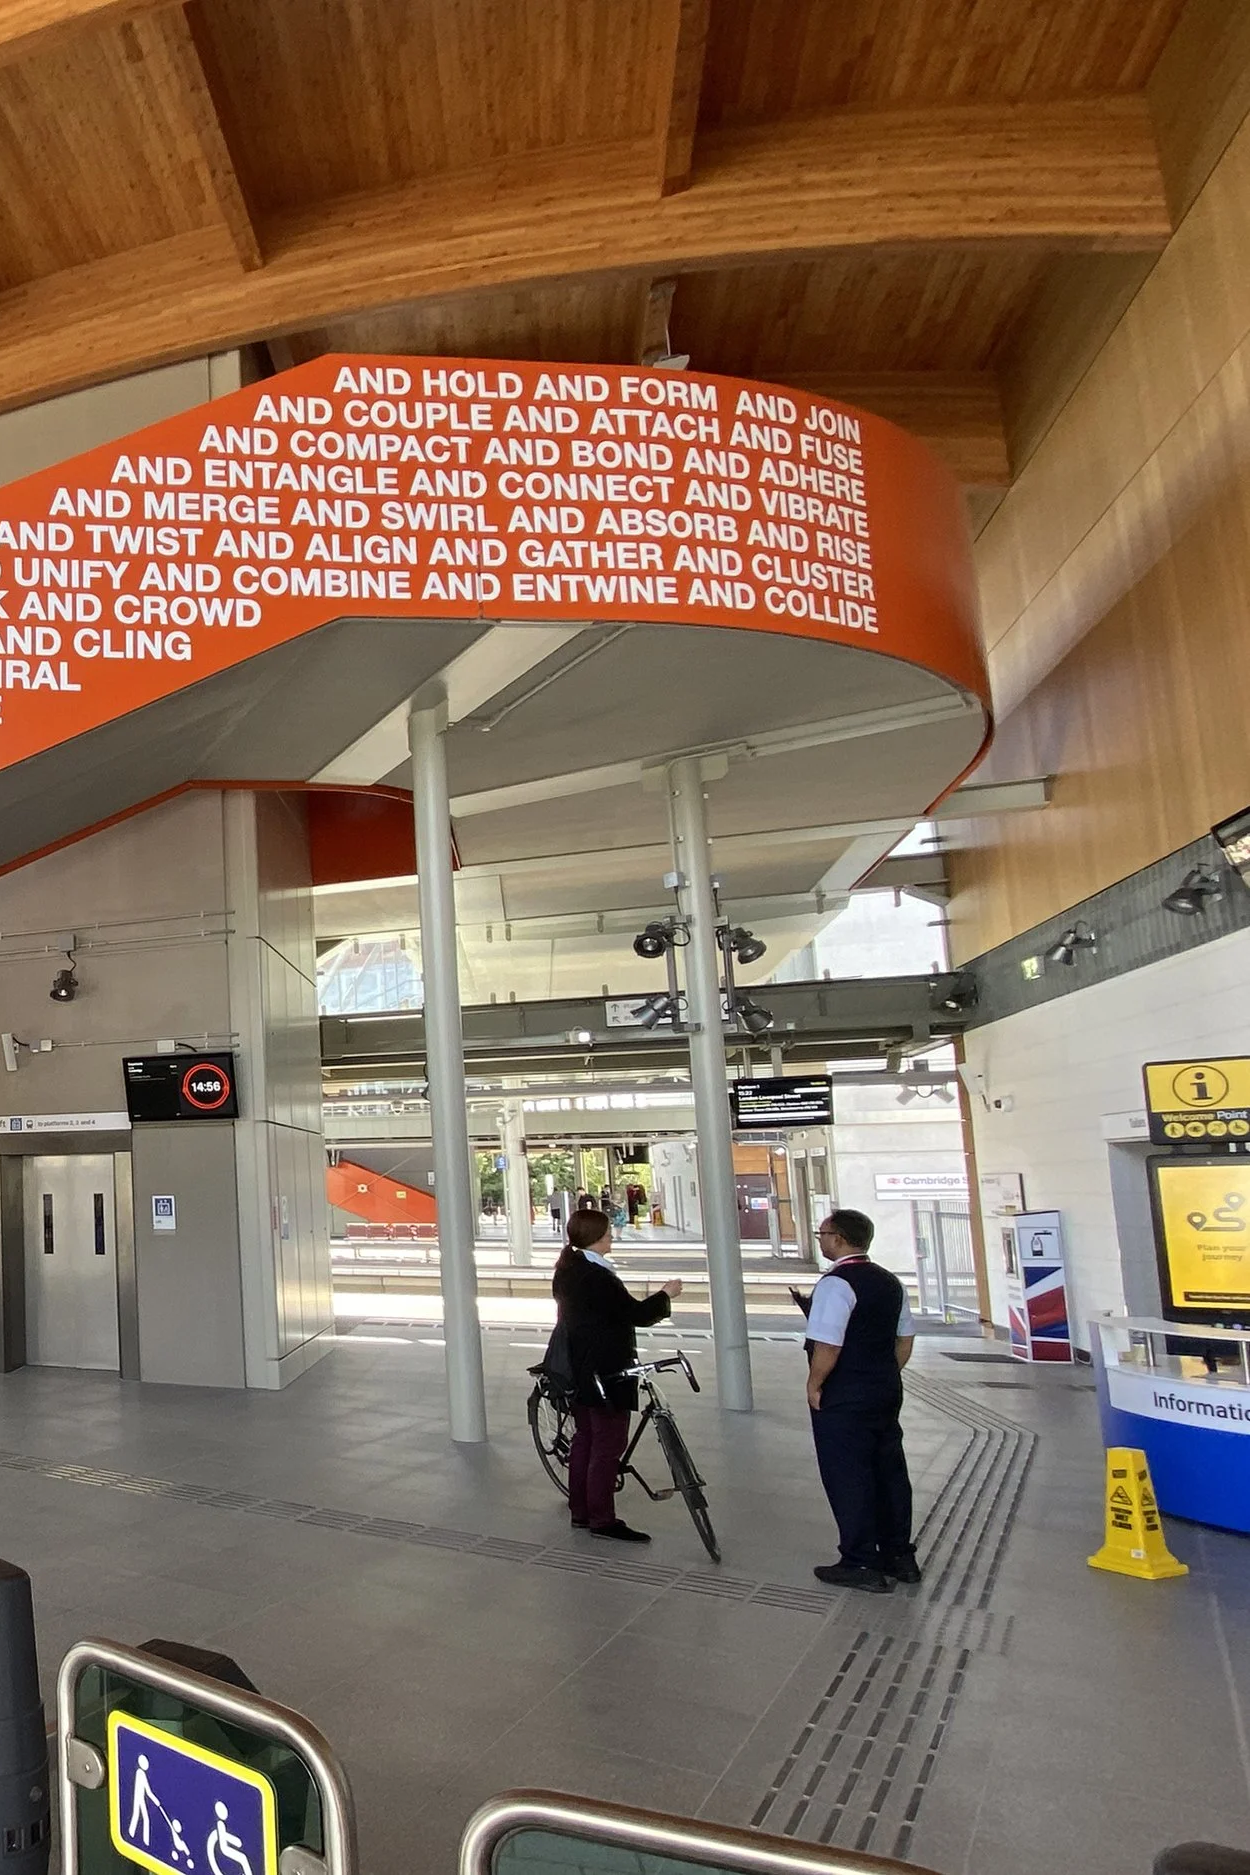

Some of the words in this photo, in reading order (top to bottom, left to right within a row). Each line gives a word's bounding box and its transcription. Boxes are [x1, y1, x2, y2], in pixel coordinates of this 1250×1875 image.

[253, 394, 333, 425] AND
[343, 399, 494, 431] COUPLE
[503, 405, 580, 434] AND
[589, 408, 721, 444] ATTACH
[729, 421, 792, 455] AND
[799, 433, 864, 476] FUSE
[333, 366, 412, 395] AND
[422, 369, 523, 399] HOLD
[533, 373, 610, 402] AND
[620, 376, 718, 412] FORM
[735, 390, 797, 424] AND
[805, 405, 860, 444] JOIN
[110, 455, 192, 486] AND
[204, 458, 400, 495] ENTANGLE
[409, 468, 488, 499] AND
[498, 471, 675, 503] CONNECT
[684, 479, 752, 511] AND
[758, 488, 869, 538] VIBRATE
[198, 425, 279, 456] AND
[290, 429, 472, 464] COMPACT
[483, 437, 560, 466] AND
[571, 440, 674, 471] BOND
[683, 447, 750, 480] AND
[759, 457, 866, 506] ADHERE
[49, 487, 132, 519] AND
[144, 491, 281, 525] MERGE
[290, 498, 370, 529] AND
[381, 501, 498, 533] SWIRL
[507, 505, 585, 534] AND
[595, 507, 739, 543] ABSORB
[747, 519, 809, 553] AND
[816, 531, 872, 570] RISE
[84, 524, 204, 556] TWIST
[213, 529, 294, 560] AND
[304, 533, 418, 565] ALIGN
[428, 537, 508, 567] AND
[518, 539, 664, 571] GATHER
[673, 544, 743, 577] AND
[751, 553, 875, 601] CLUSTER
[14, 557, 130, 590] UNIFY
[139, 562, 221, 593] AND
[232, 565, 412, 599] COMBINE
[421, 571, 501, 602] AND
[512, 573, 679, 604] ENTWINE
[687, 578, 756, 610] AND
[764, 586, 879, 633] COLLIDE
[18, 591, 102, 623] AND
[114, 594, 262, 628] CROWD
[73, 627, 192, 661] CLING
[191, 1081, 221, 1093] 14:56
[1162, 1113, 1215, 1122] Welcome
[1216, 1110, 1248, 1120] Point
[903, 1175, 961, 1187] Cambridge
[1202, 1254, 1243, 1262] journey
